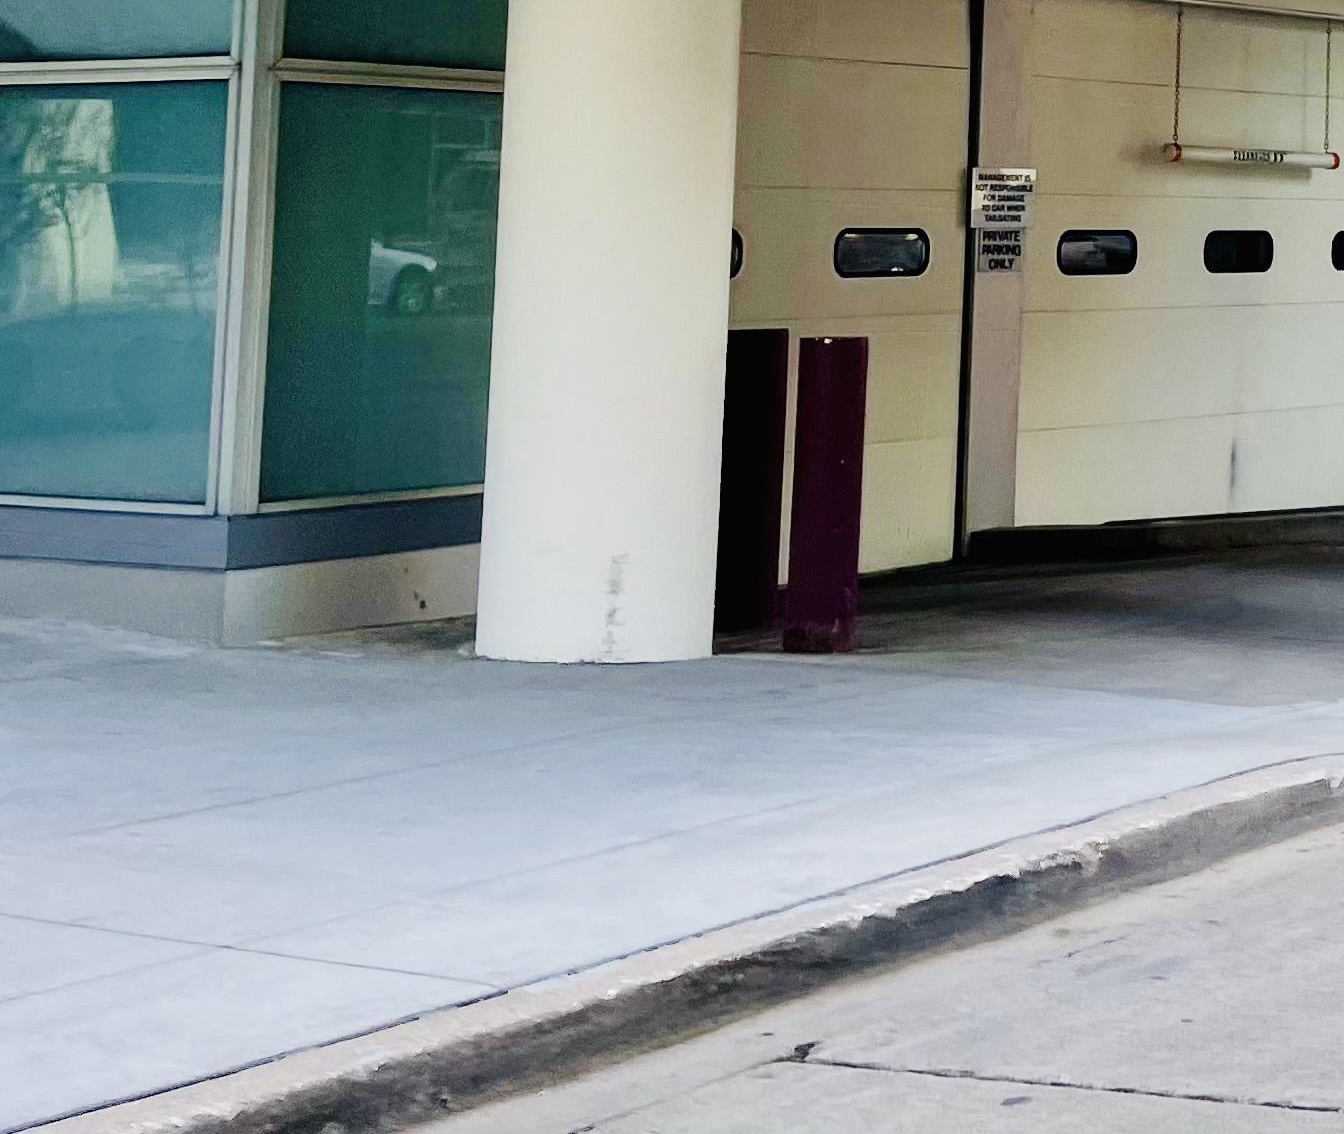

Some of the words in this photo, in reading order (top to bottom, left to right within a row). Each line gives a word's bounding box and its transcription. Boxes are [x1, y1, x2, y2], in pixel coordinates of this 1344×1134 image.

[978, 174, 1023, 182] MANAGEMENT
[975, 184, 988, 192] NOT
[982, 230, 1021, 242] PRIVATE
[981, 244, 1022, 257] PARKING
[988, 258, 1015, 270] ONLY
